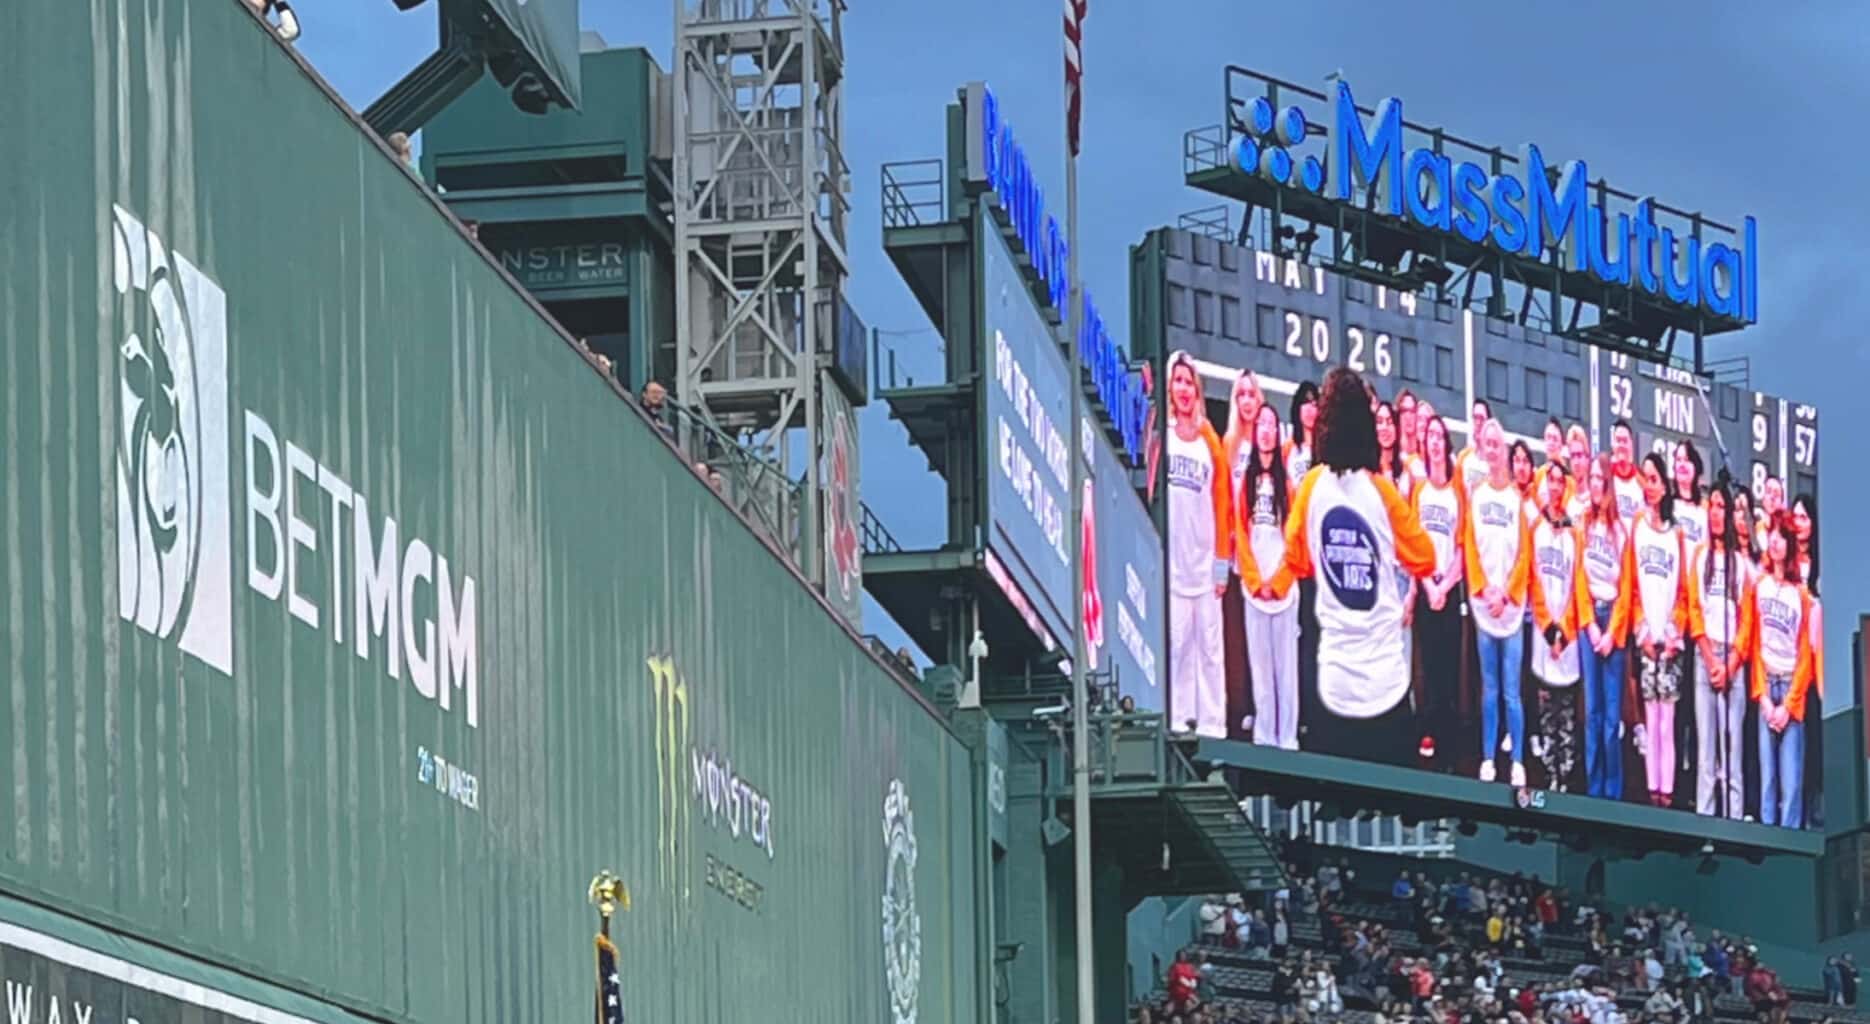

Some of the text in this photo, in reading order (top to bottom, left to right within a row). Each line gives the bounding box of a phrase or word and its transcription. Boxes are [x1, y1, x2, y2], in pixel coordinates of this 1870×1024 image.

[1328, 77, 1757, 323] MassMutual
[1610, 375, 1816, 466] 52 MIN 9 57
[245, 409, 477, 728] BETMGM
[692, 746, 774, 860] MONSTER
